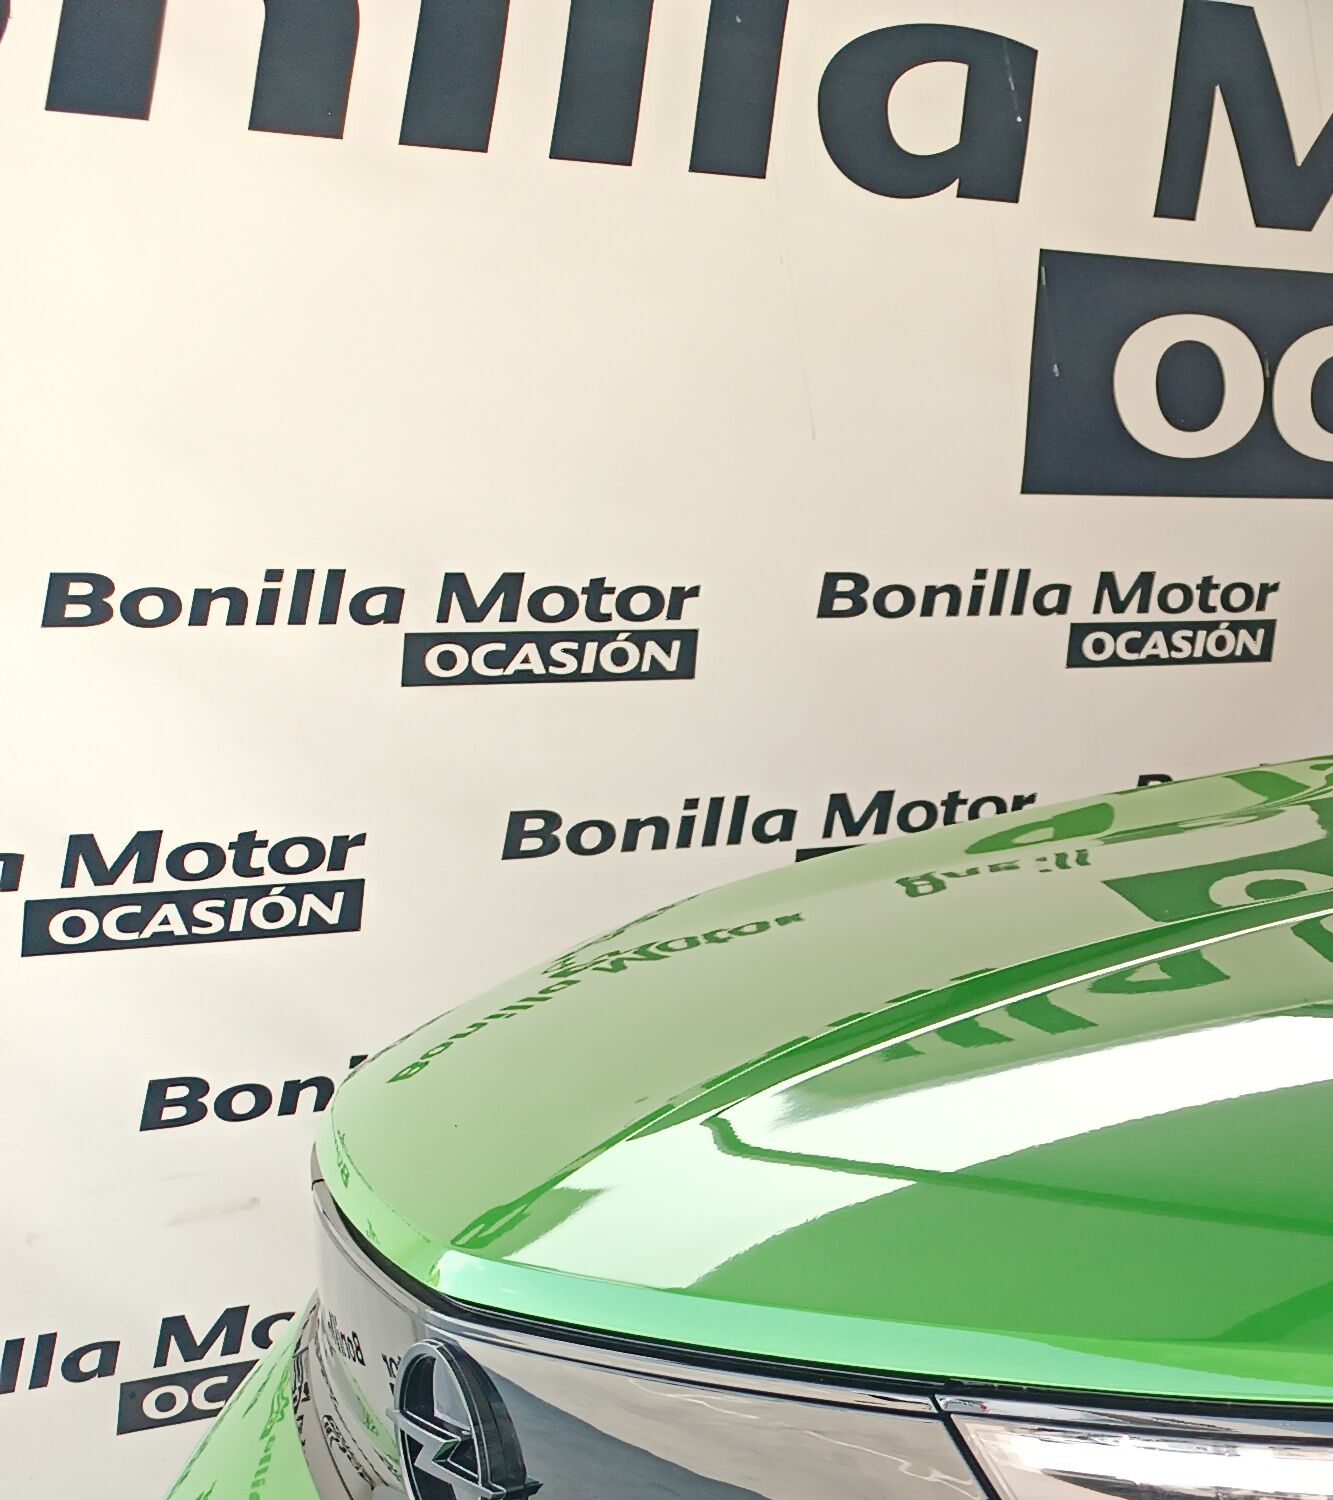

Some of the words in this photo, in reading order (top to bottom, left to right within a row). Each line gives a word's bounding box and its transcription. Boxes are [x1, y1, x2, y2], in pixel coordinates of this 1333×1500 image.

[0, 0, 1038, 204] nilla
[41, 569, 405, 628] Bonilla
[436, 572, 700, 624] Motor
[817, 569, 1072, 618] Bonilla
[1093, 572, 1280, 614] Motor
[425, 634, 681, 678] OCASIÓN
[1082, 623, 1265, 661] OCASIÓN
[502, 795, 797, 860] Bonilla
[822, 790, 1037, 839] Motor
[61, 830, 366, 888] Motor
[49, 886, 344, 944] OCASIÓN
